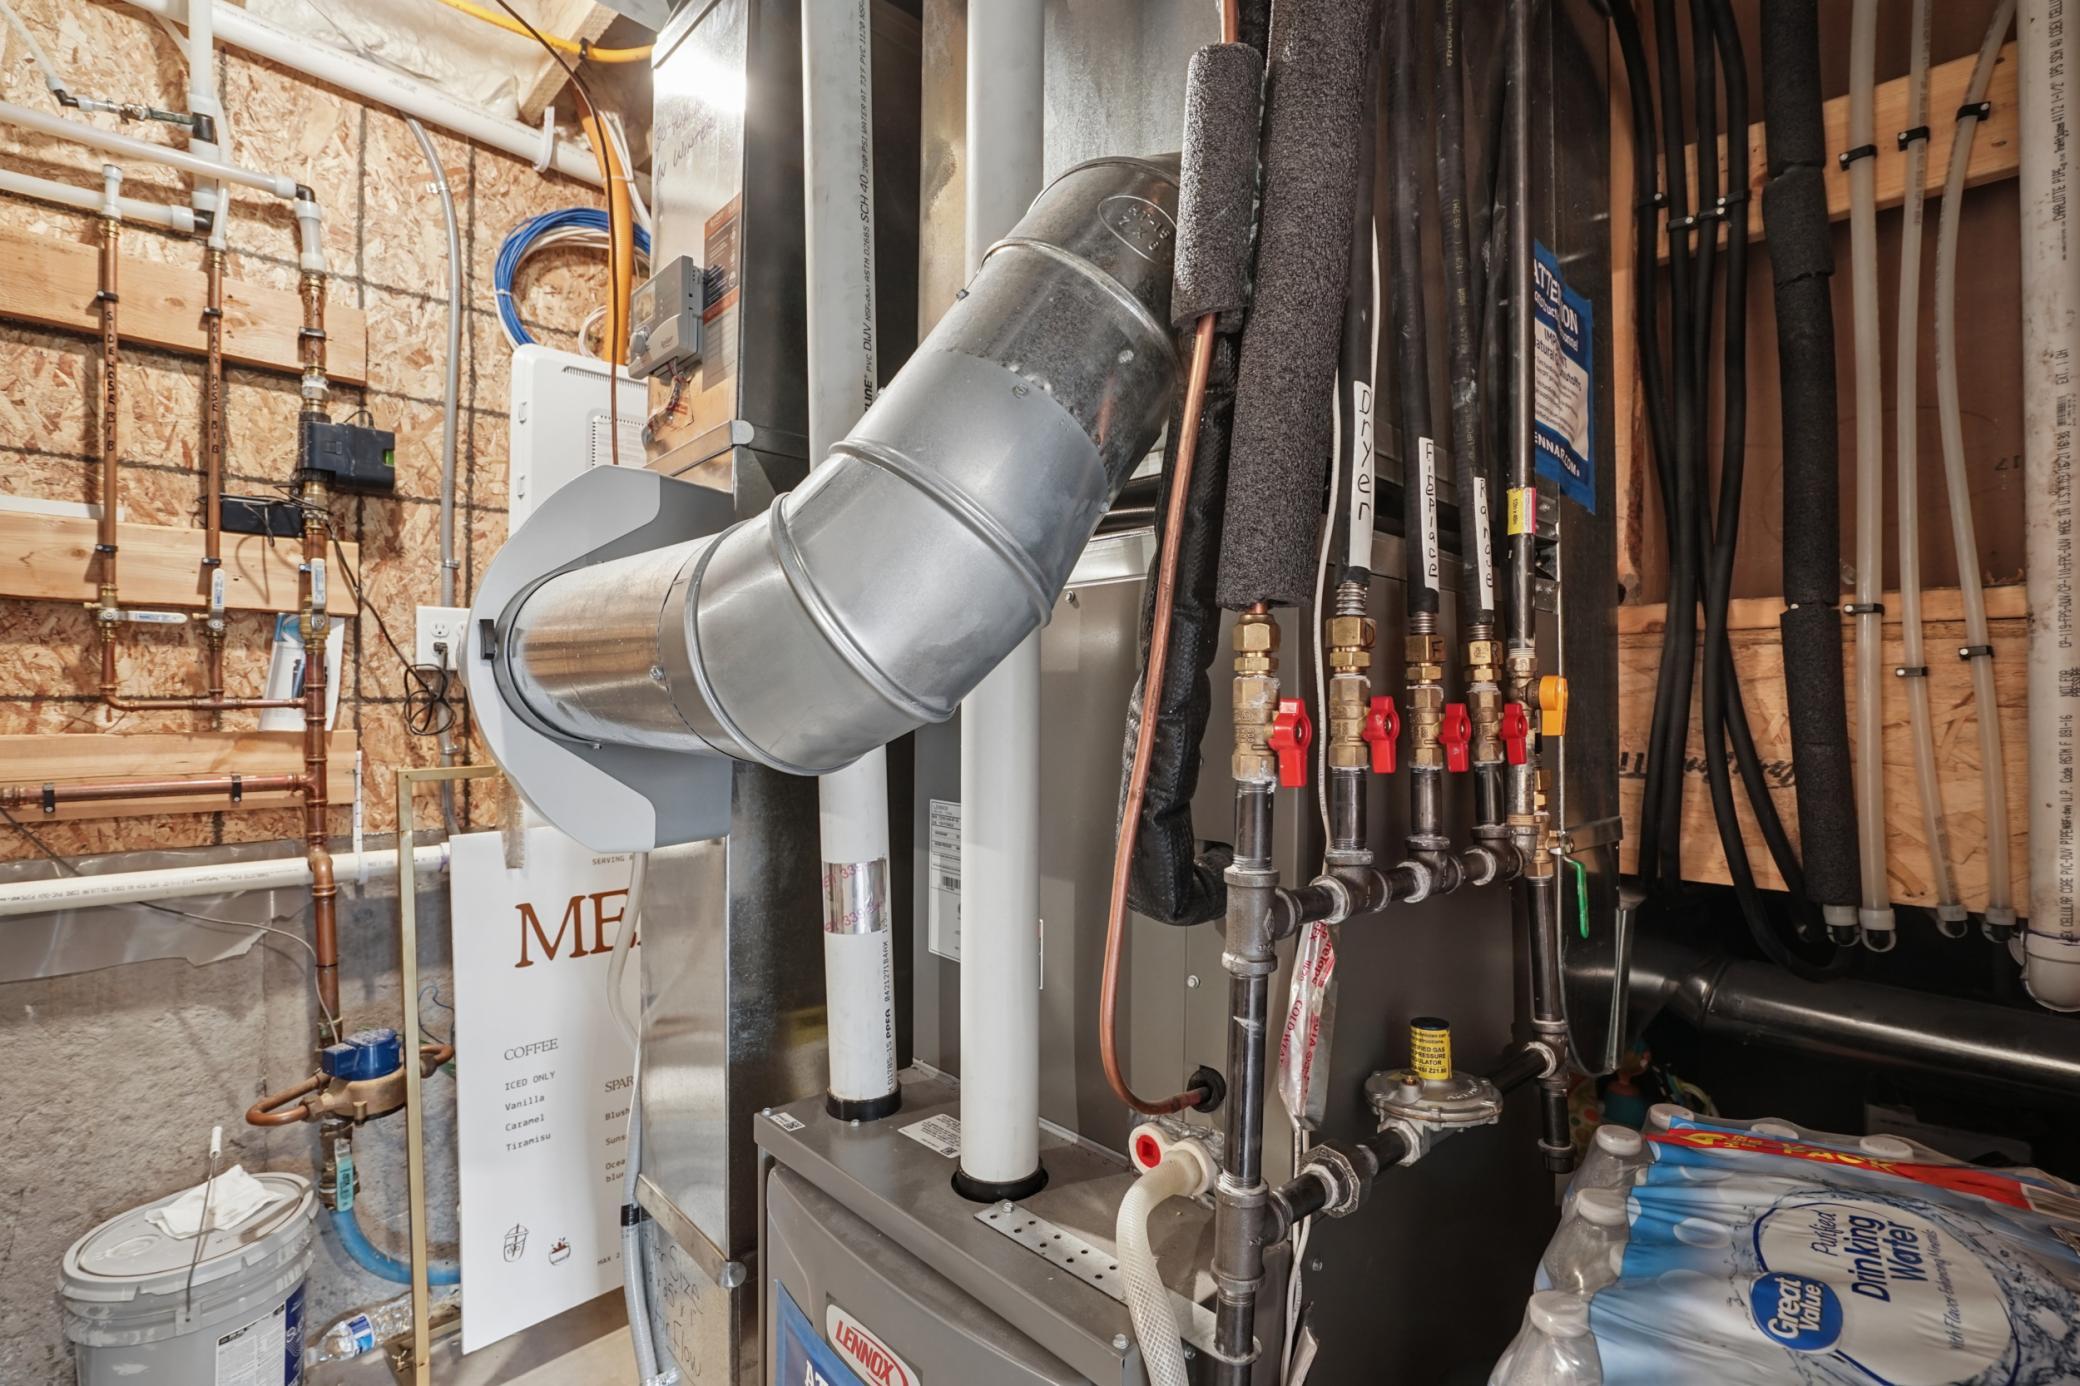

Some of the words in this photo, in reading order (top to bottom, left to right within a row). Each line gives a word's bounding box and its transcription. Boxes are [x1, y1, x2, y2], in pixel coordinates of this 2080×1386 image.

[859, 174, 869, 193] 40
[860, 194, 869, 224] SCH
[2052, 185, 2066, 222] CHARLOTTE
[106, 310, 115, 355] SIDE
[106, 361, 116, 406] HOSE
[211, 374, 220, 413] HOSE
[2057, 519, 2071, 536] MADE
[2059, 714, 2072, 738] 891-16
[2059, 749, 2072, 765] ASTM
[2059, 767, 2072, 784] Code
[592, 855, 625, 865] SERVING
[2059, 879, 2073, 894] CORE
[514, 888, 640, 968] ME
[1288, 999, 1304, 1031] COLD
[504, 1038, 559, 1061] COFFEE
[504, 1078, 528, 1091] ICED
[532, 1070, 556, 1083] ONLY
[504, 1095, 545, 1111] Vanilla
[605, 1107, 631, 1121] Blush
[505, 1113, 545, 1132] Caramel
[506, 1133, 551, 1151] Tiramisu
[1809, 1209, 1844, 1257] Purified
[1843, 1215, 1891, 1303] Drinking
[1882, 1220, 1929, 1282] Water
[1767, 1277, 1802, 1339] Great
[1799, 1283, 1824, 1331] Value
[835, 1320, 894, 1386] LENNOX
